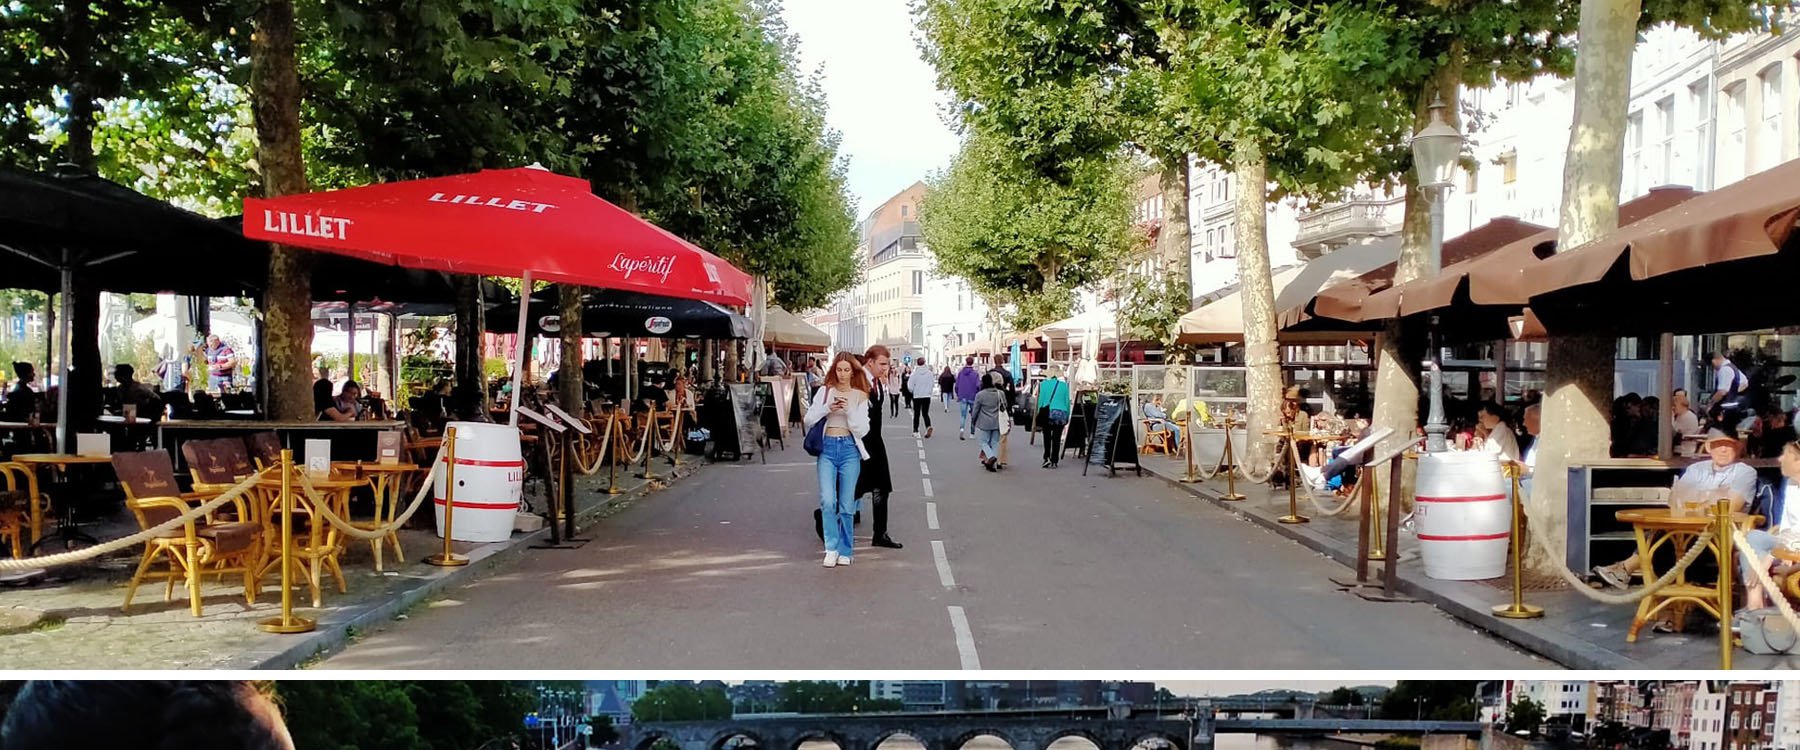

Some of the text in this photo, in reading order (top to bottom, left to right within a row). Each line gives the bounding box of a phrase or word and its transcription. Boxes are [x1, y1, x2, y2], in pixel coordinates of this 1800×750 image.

[428, 192, 556, 213] LILLET
[263, 209, 351, 240] LILLET
[607, 252, 677, 284] L'apéritif
